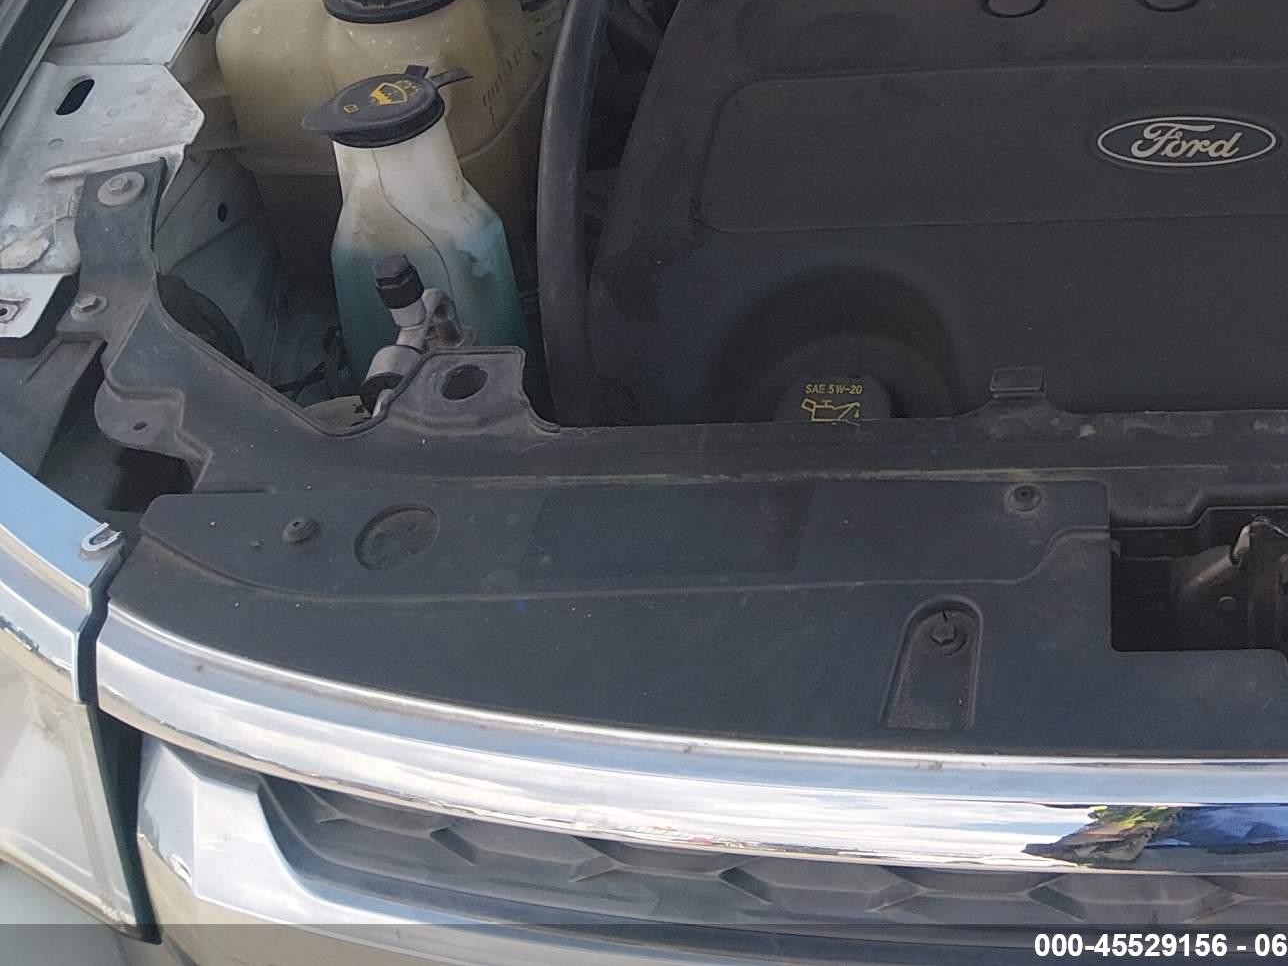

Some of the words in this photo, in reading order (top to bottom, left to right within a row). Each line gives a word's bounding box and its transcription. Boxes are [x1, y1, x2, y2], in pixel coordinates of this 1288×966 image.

[1131, 122, 1242, 158] Ford
[804, 384, 826, 394] SAE
[828, 384, 863, 395] 5W-20
